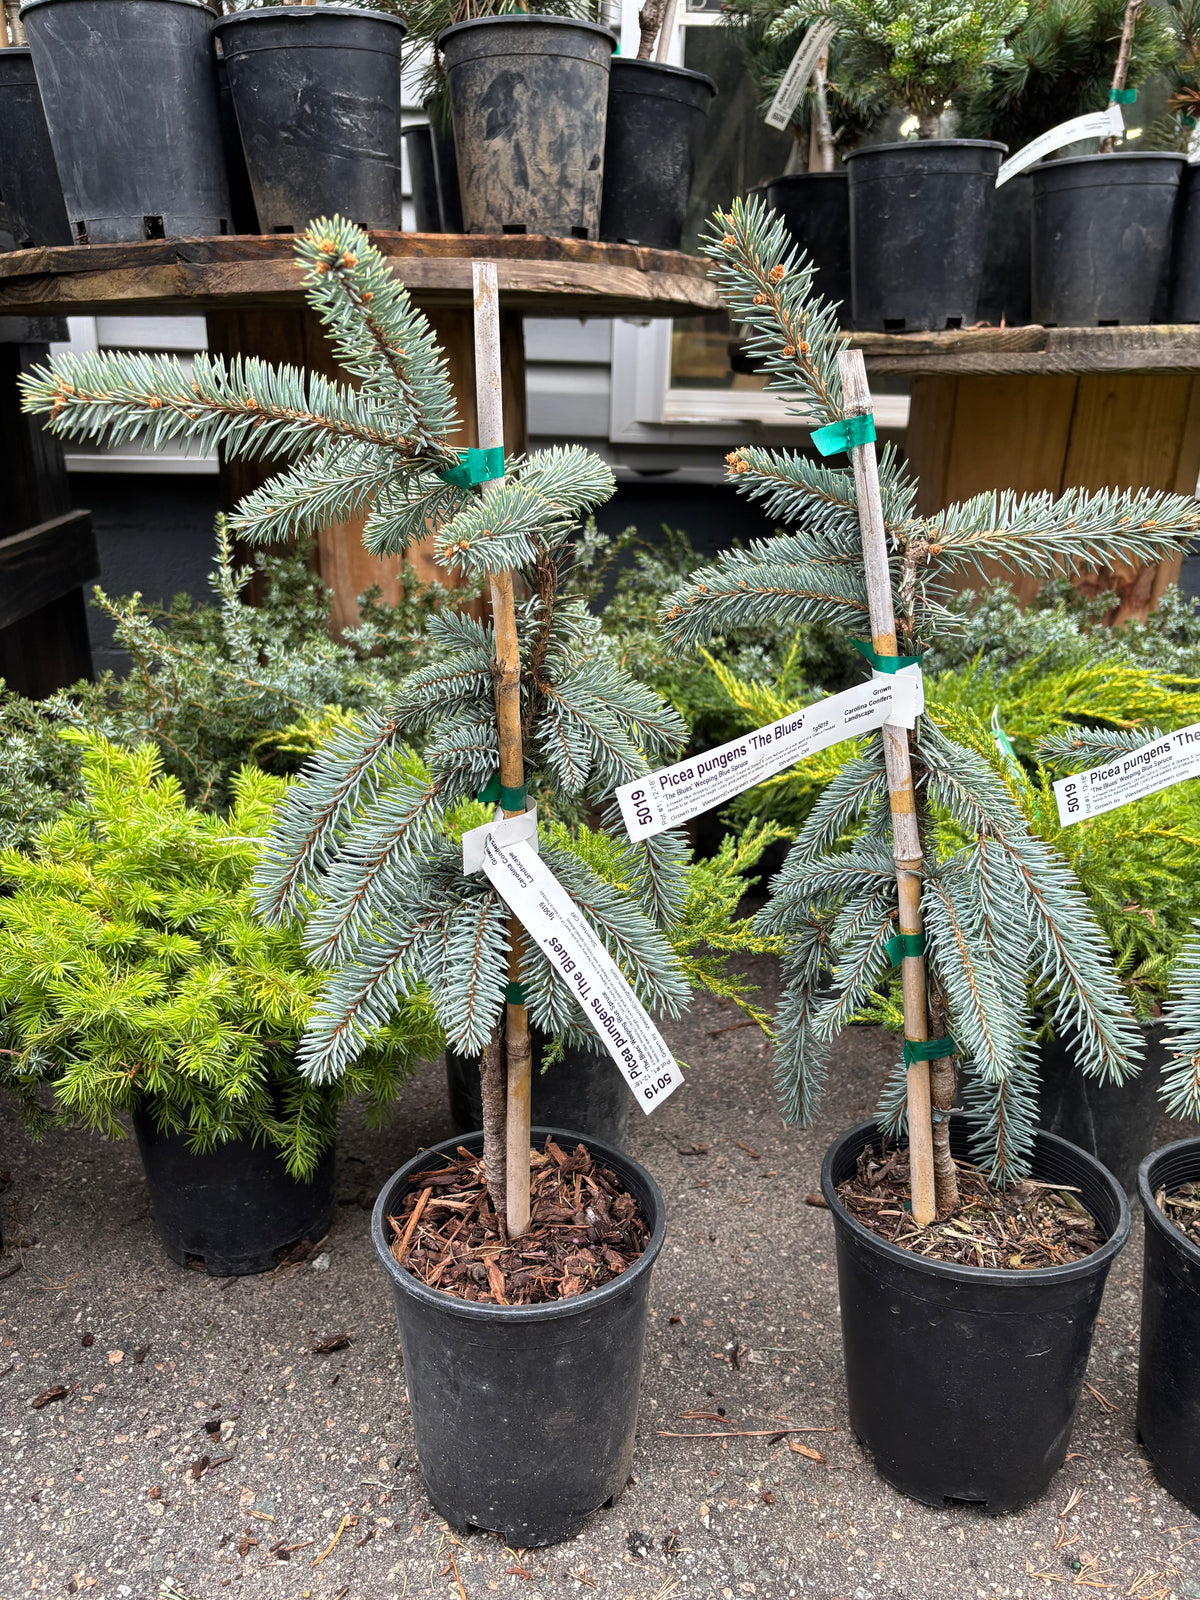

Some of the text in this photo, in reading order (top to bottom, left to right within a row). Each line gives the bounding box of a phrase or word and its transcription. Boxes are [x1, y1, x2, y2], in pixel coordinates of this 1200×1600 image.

[872, 685, 892, 696] Grown
[844, 694, 893, 716] Carolina Conifers
[844, 708, 875, 724] Landscape
[659, 714, 805, 790] Picea pungens 'The Blues'
[1090, 765, 1121, 784] Picea
[1123, 742, 1171, 774] pungens
[1173, 729, 1200, 746] 'The
[694, 774, 718, 788] Weeping
[718, 768, 730, 778] Blue
[730, 760, 749, 772] Spruce
[1119, 770, 1141, 782] Weeping
[1141, 764, 1153, 773] Blue
[1153, 755, 1173, 767] Spruce
[631, 790, 653, 826] 5019
[1064, 783, 1080, 813] 5019
[1094, 800, 1113, 810] Grown
[659, 813, 668, 826] Pot
[670, 810, 690, 821] Grown
[491, 840, 527, 888] Carolina Conifers
[509, 852, 534, 884] Landscape
[543, 937, 643, 1080] Picea pungens 'The Blues'
[602, 992, 616, 1011] Spruce
[613, 1009, 623, 1024] Blue
[621, 1021, 637, 1046] Weeping
[651, 1033, 657, 1041] by
[655, 1040, 667, 1058] Grown
[644, 1073, 672, 1099] 5019
